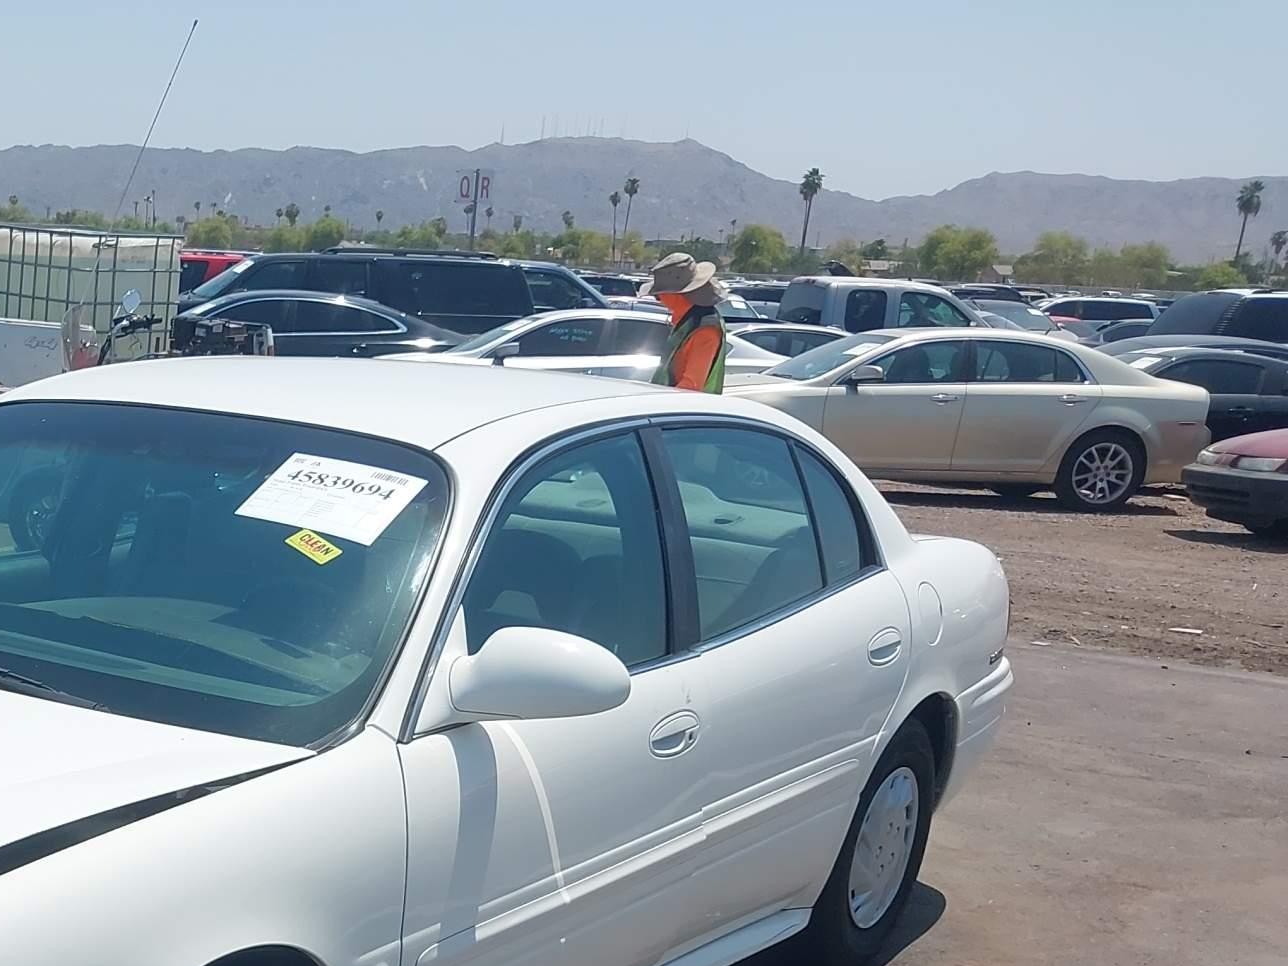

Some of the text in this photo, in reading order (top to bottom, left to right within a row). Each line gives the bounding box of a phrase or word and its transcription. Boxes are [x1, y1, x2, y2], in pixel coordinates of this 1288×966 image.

[459, 175, 490, 199] Q R
[287, 469, 396, 500] 45839694
[299, 533, 335, 556] CLEAN
